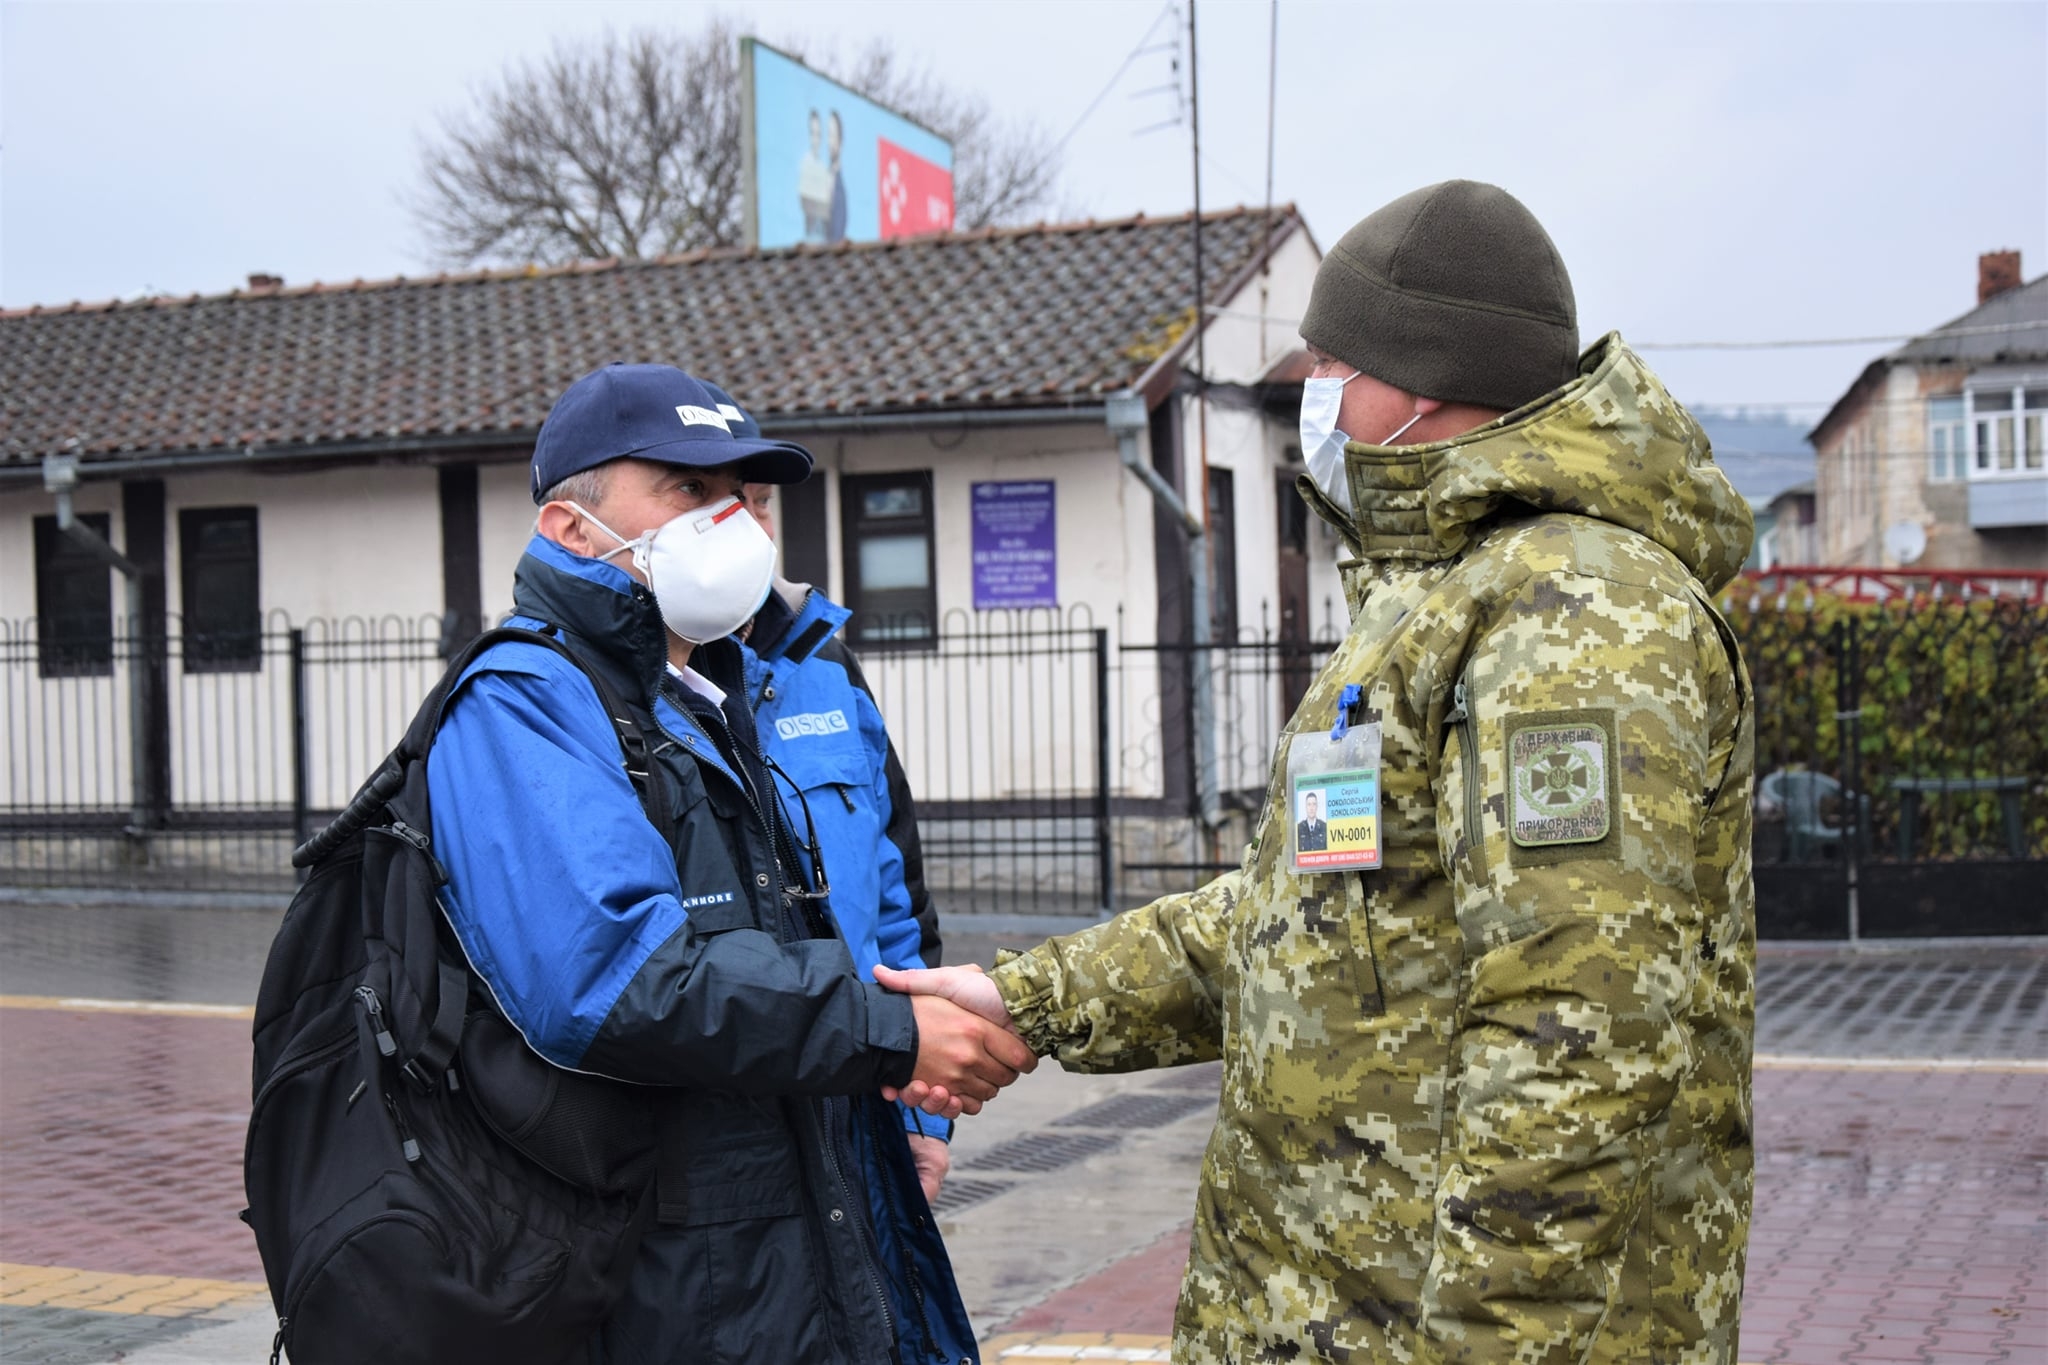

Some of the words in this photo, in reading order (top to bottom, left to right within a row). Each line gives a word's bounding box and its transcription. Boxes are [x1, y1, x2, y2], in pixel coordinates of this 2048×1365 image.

[1527, 730, 1593, 746] ДЕРЖАВНА
[1518, 816, 1603, 832] ПРИКОРДОННА
[1330, 826, 1371, 842] VN-0001
[1537, 828, 1584, 839] СЛУЖБА
